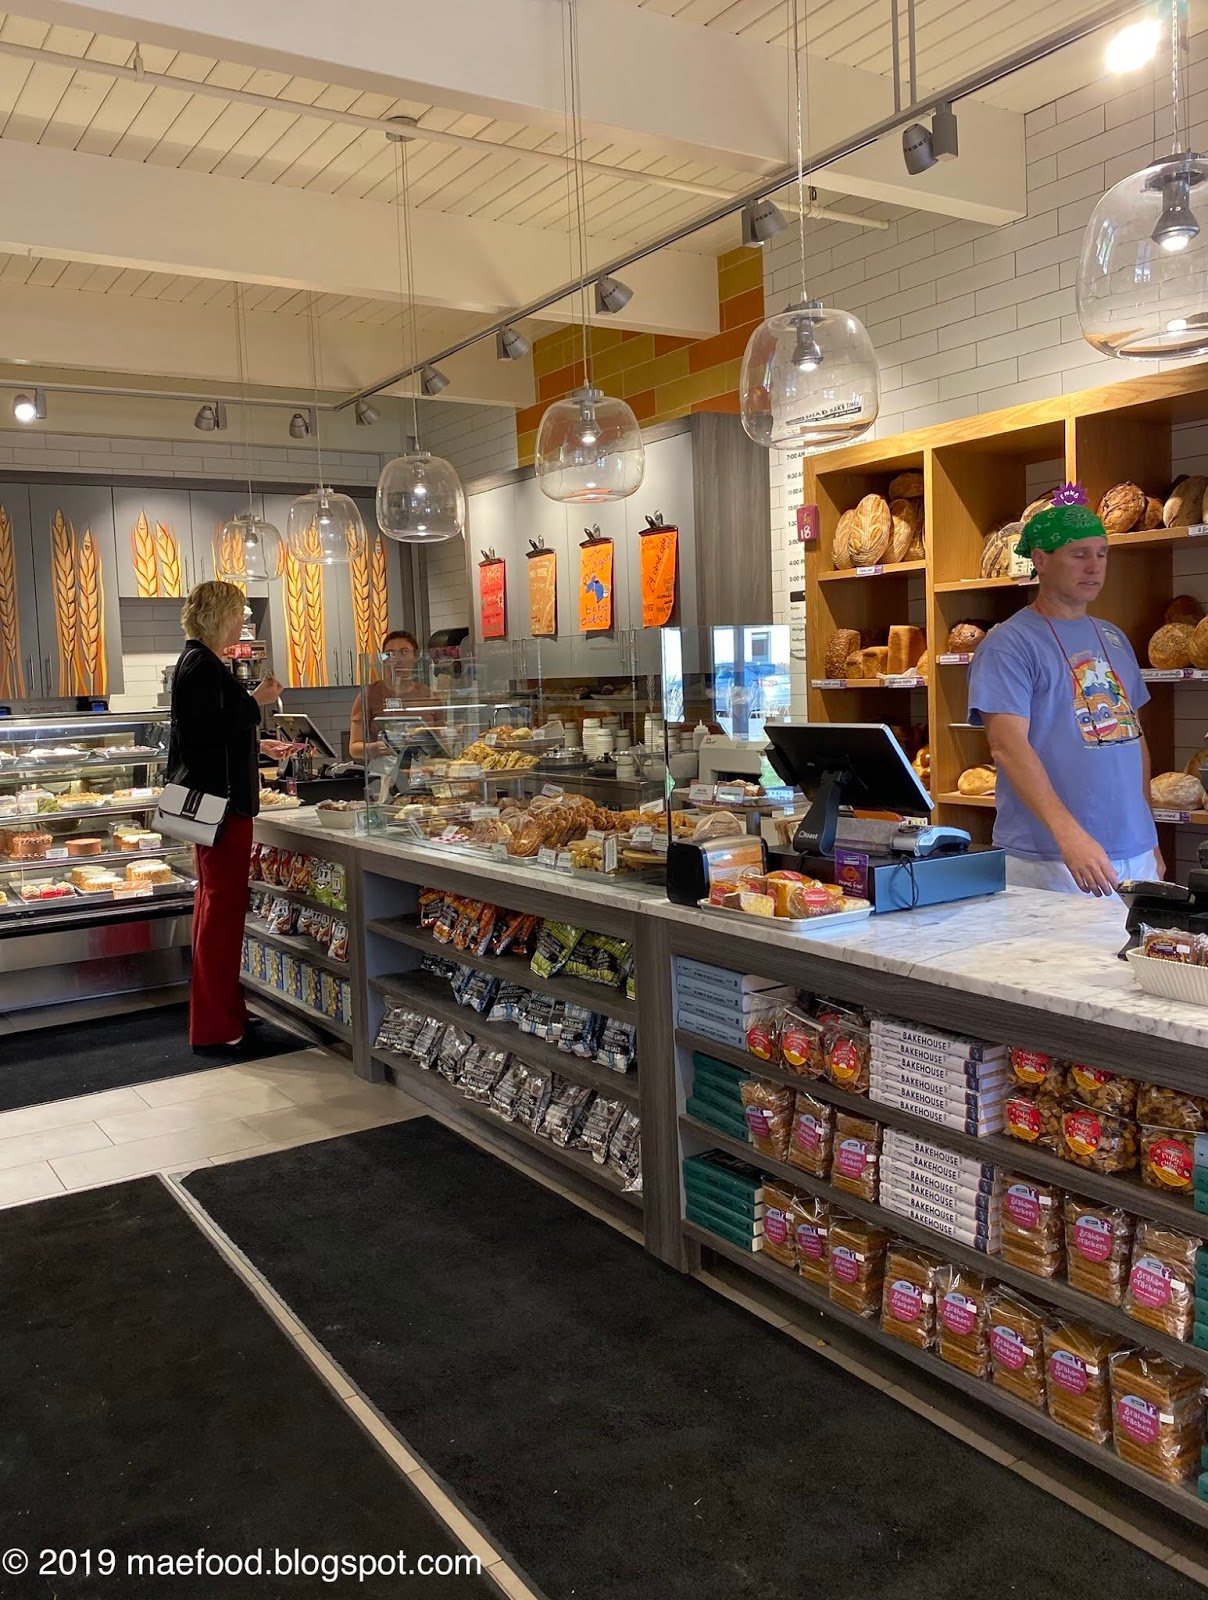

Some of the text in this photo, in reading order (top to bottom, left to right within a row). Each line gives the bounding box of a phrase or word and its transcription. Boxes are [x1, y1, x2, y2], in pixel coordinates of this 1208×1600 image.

[804, 832, 819, 840] toast
[902, 1031, 947, 1050] BAKEHOUSE
[900, 1045, 943, 1064] BAKEHOUSE
[901, 1059, 944, 1078] BAKEHOUSE
[900, 1075, 944, 1095] BAKEHOUSE
[901, 1088, 944, 1108] BAKEHOUSE
[900, 1101, 943, 1122] BAKEHOUSE
[914, 1143, 959, 1166] BAKEHOUSE
[913, 1156, 957, 1180] BAKEHOUSE
[910, 1170, 954, 1194] BAKEHOUSE
[910, 1184, 954, 1208] BAKEHOUSE
[910, 1198, 954, 1223] BAKEHOUSE
[910, 1211, 953, 1235] BAKEHOUSE
